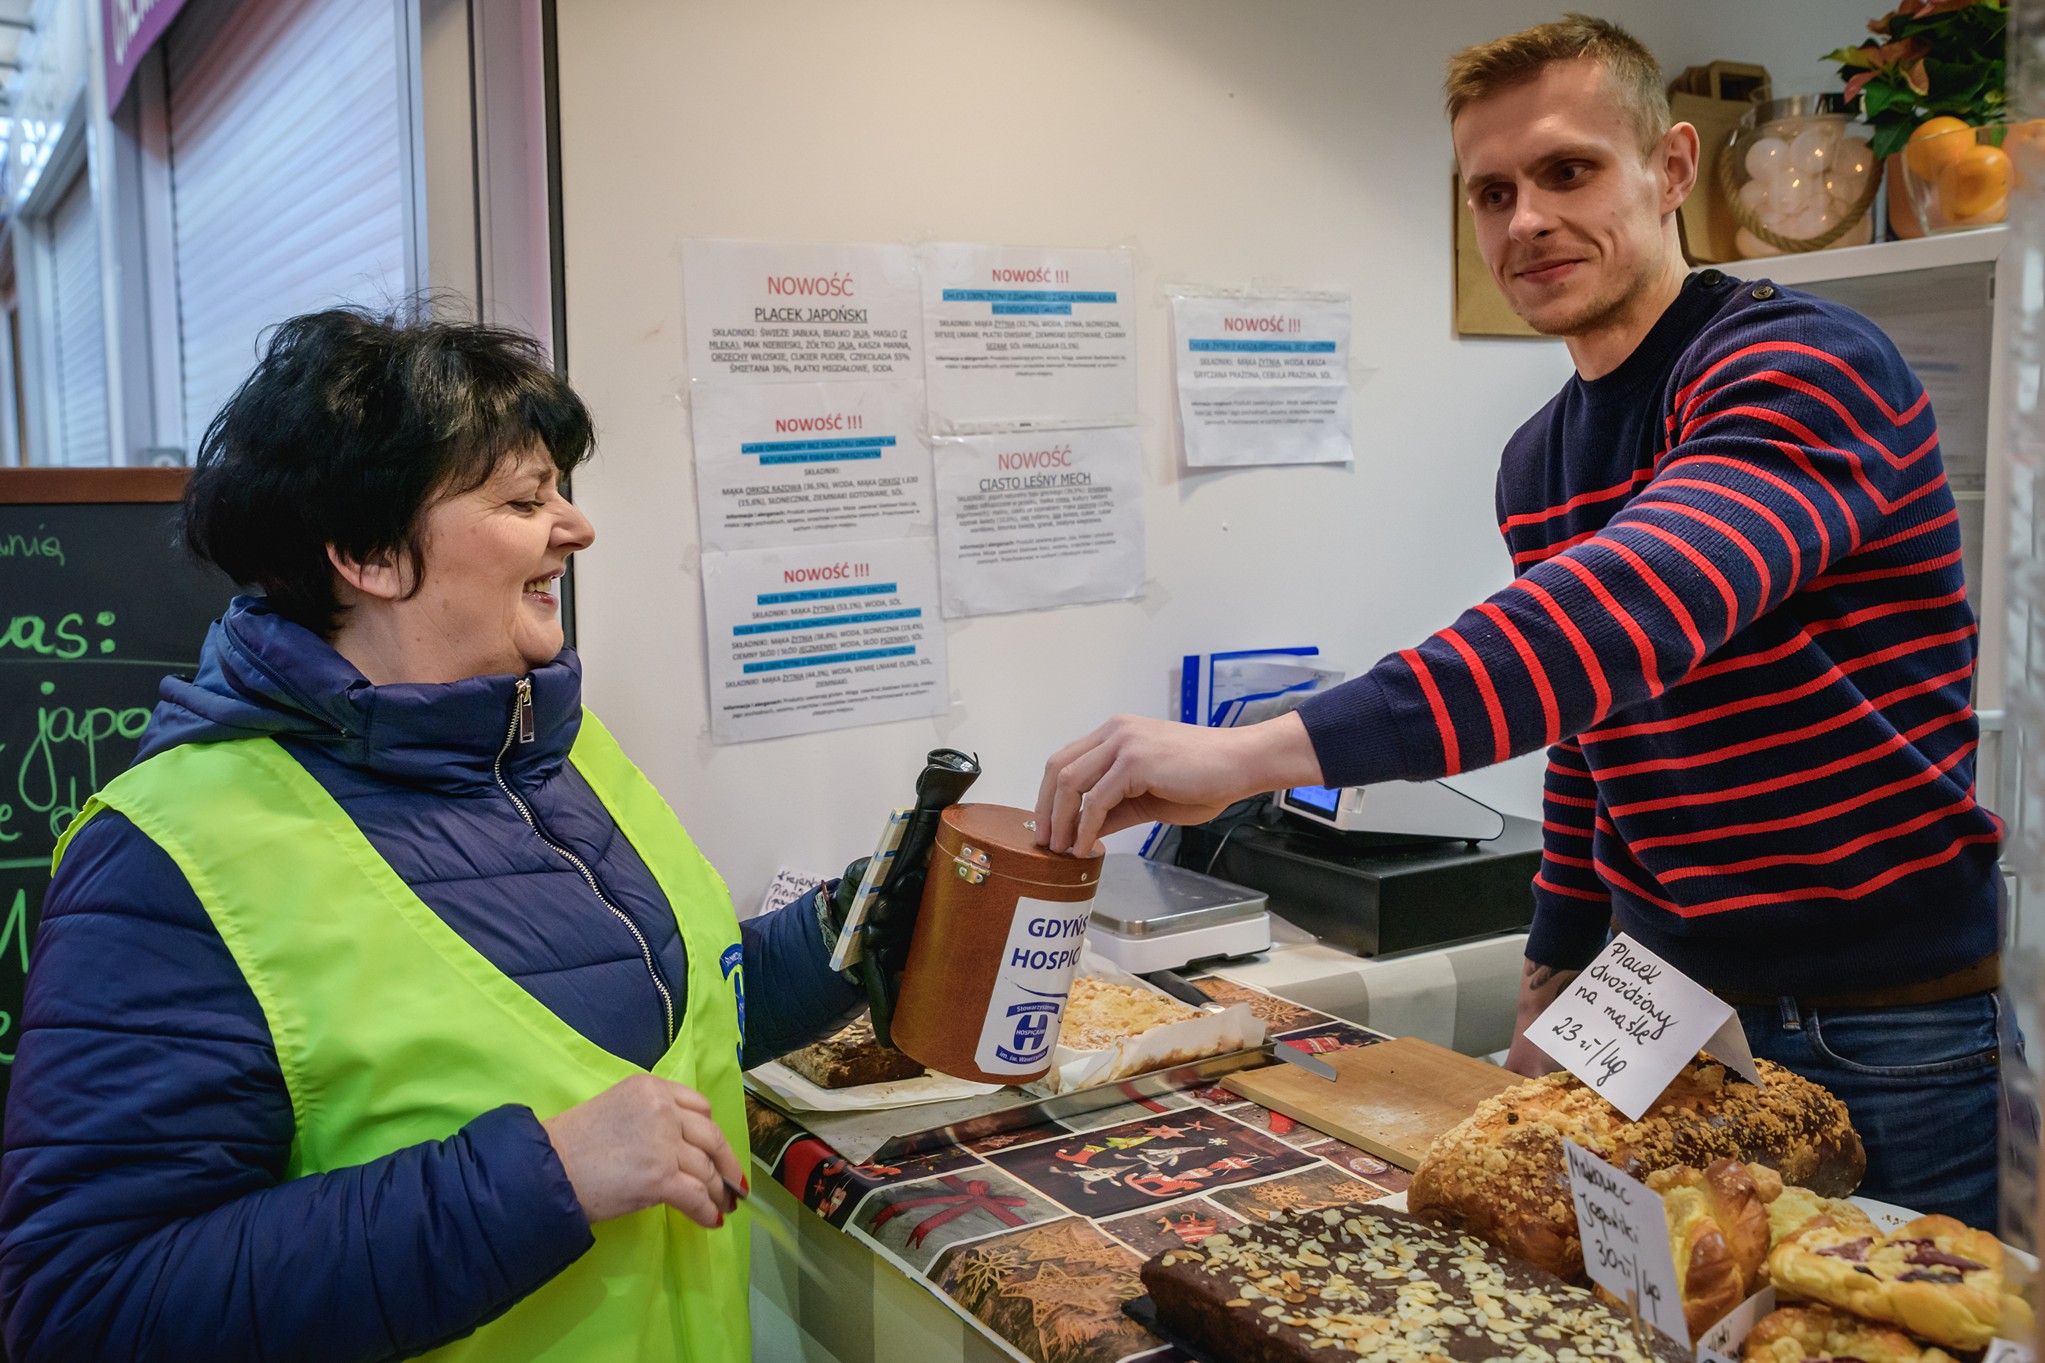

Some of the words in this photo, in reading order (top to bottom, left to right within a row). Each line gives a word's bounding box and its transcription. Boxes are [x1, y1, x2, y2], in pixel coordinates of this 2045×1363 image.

[992, 267, 1051, 283] NOWOŚĆ
[1056, 270, 1070, 283] !!!
[768, 272, 854, 297] NOWOŚĆ
[755, 307, 802, 322] PLACEK
[807, 305, 868, 323] JAPOŃSKI
[712, 329, 757, 337] SKŁADNIKI:
[760, 327, 789, 337] ŚWIEŻE
[1224, 315, 1284, 333] NOWOŚĆ
[1288, 319, 1301, 333] !!!
[743, 341, 760, 349] MAK
[858, 341, 881, 349] KASZA
[711, 353, 748, 361] ORZECHY
[790, 353, 818, 361] CUKIER
[775, 414, 843, 433] NOWOŚĆ
[847, 415, 863, 430] !!!
[998, 445, 1072, 471] NOWOŚĆ
[980, 477, 1021, 491] CIASTO
[1024, 473, 1057, 488] LEŚNY
[1061, 473, 1092, 485] MECH
[783, 563, 850, 583] NOWOŚĆ
[855, 563, 870, 577] !!!
[1610, 942, 1662, 984] Placek
[1575, 985, 1597, 1005] na
[1604, 1006, 1650, 1045] maśle
